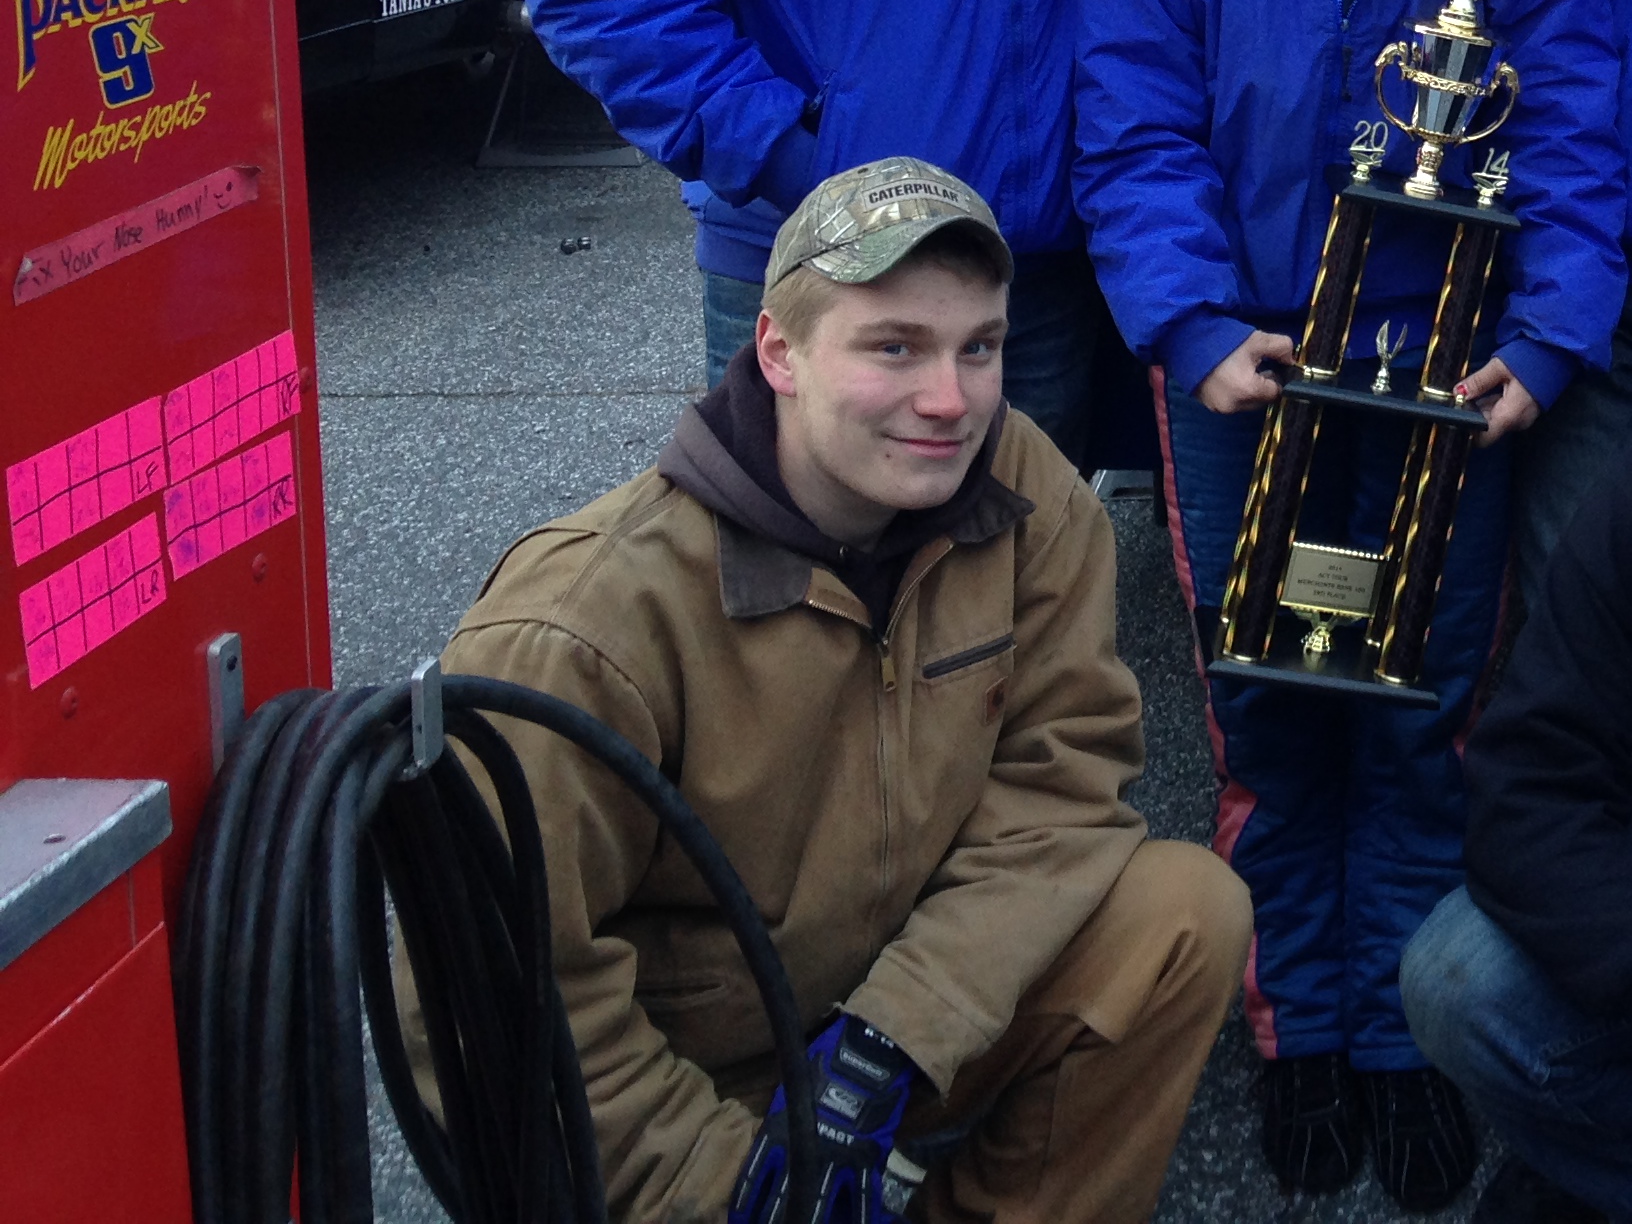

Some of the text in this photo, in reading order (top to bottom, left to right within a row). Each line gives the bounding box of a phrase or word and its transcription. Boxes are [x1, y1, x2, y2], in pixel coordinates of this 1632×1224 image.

[33, 79, 212, 192] Motorsports
[1350, 119, 1511, 176] 20 14
[868, 183, 959, 205] CATERPILLAR
